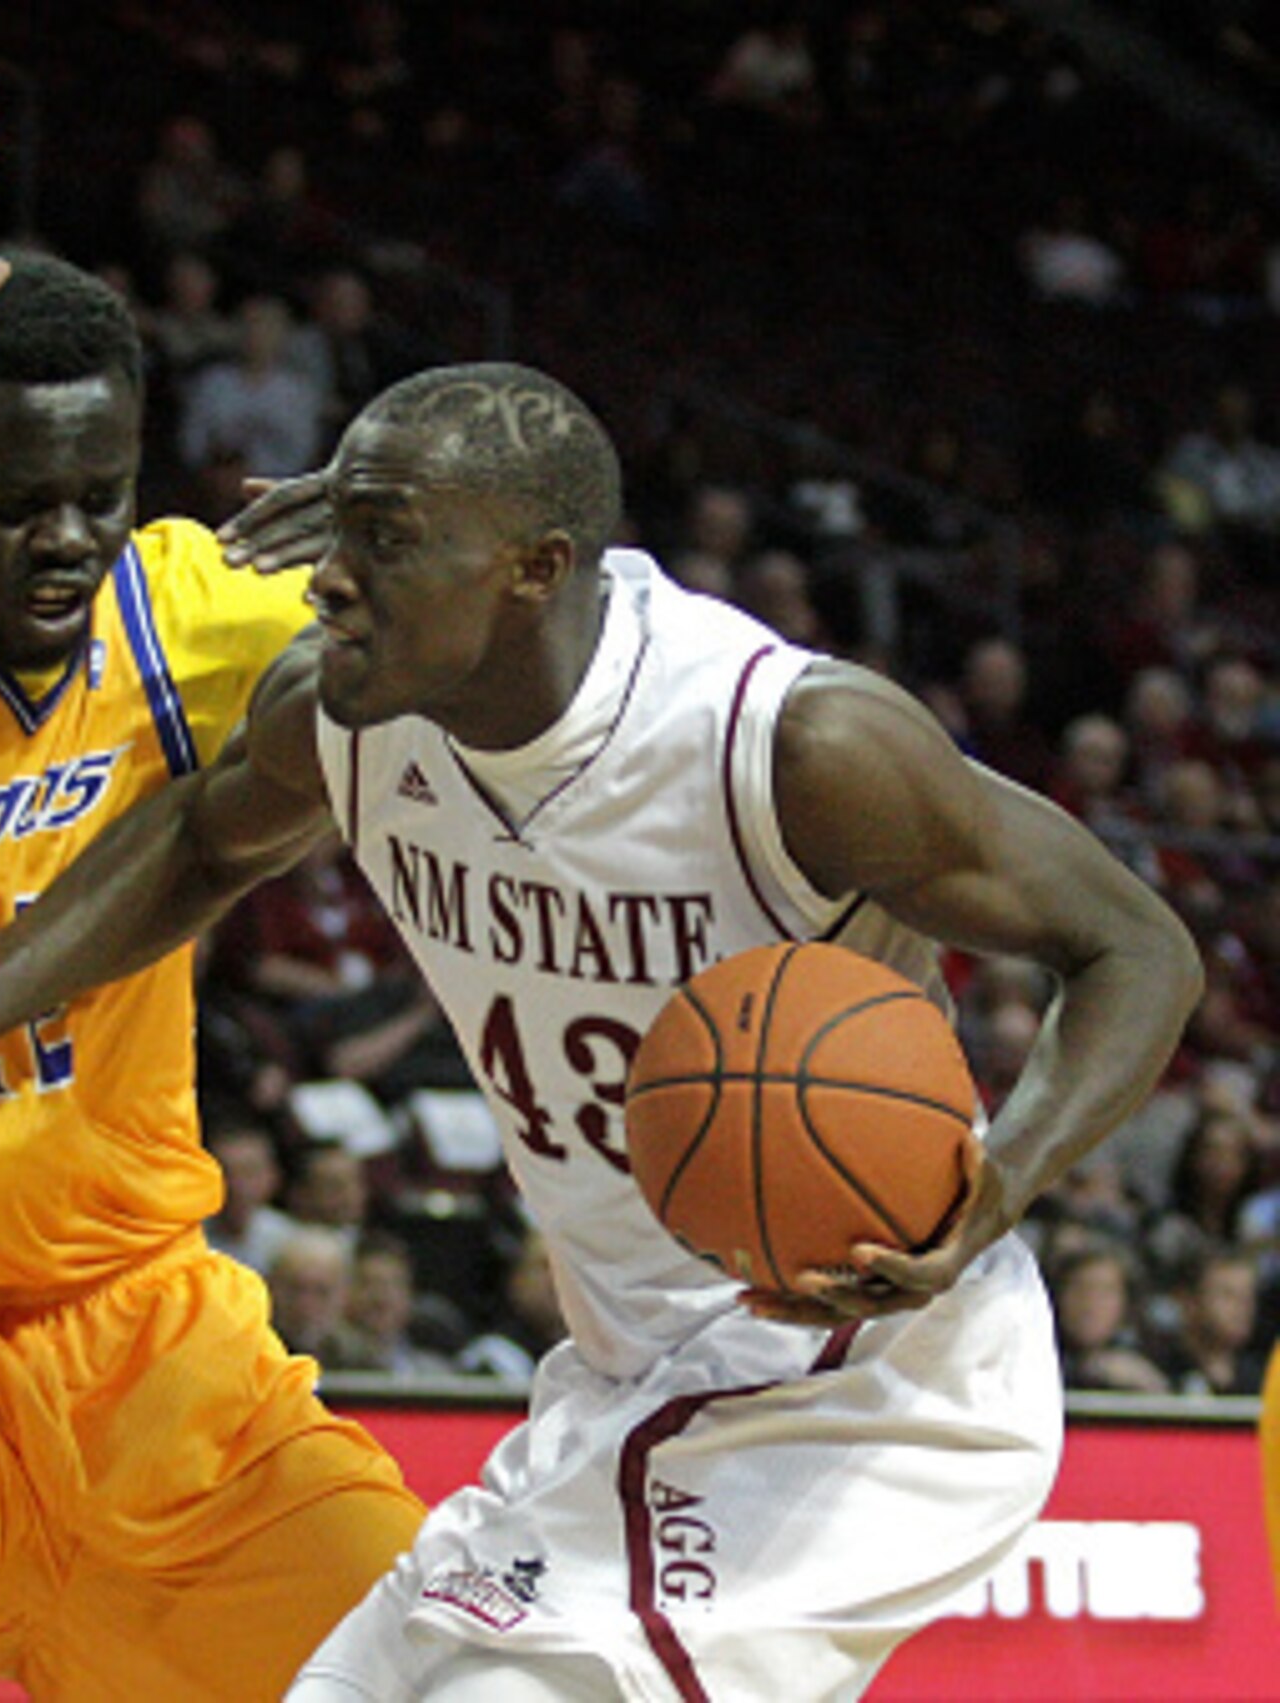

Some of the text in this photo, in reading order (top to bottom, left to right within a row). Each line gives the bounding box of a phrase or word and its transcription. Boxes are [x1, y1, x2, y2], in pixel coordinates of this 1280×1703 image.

[388, 835, 719, 987] NM STATE
[479, 992, 643, 1175] 43
[649, 1479, 717, 1612] AGG
